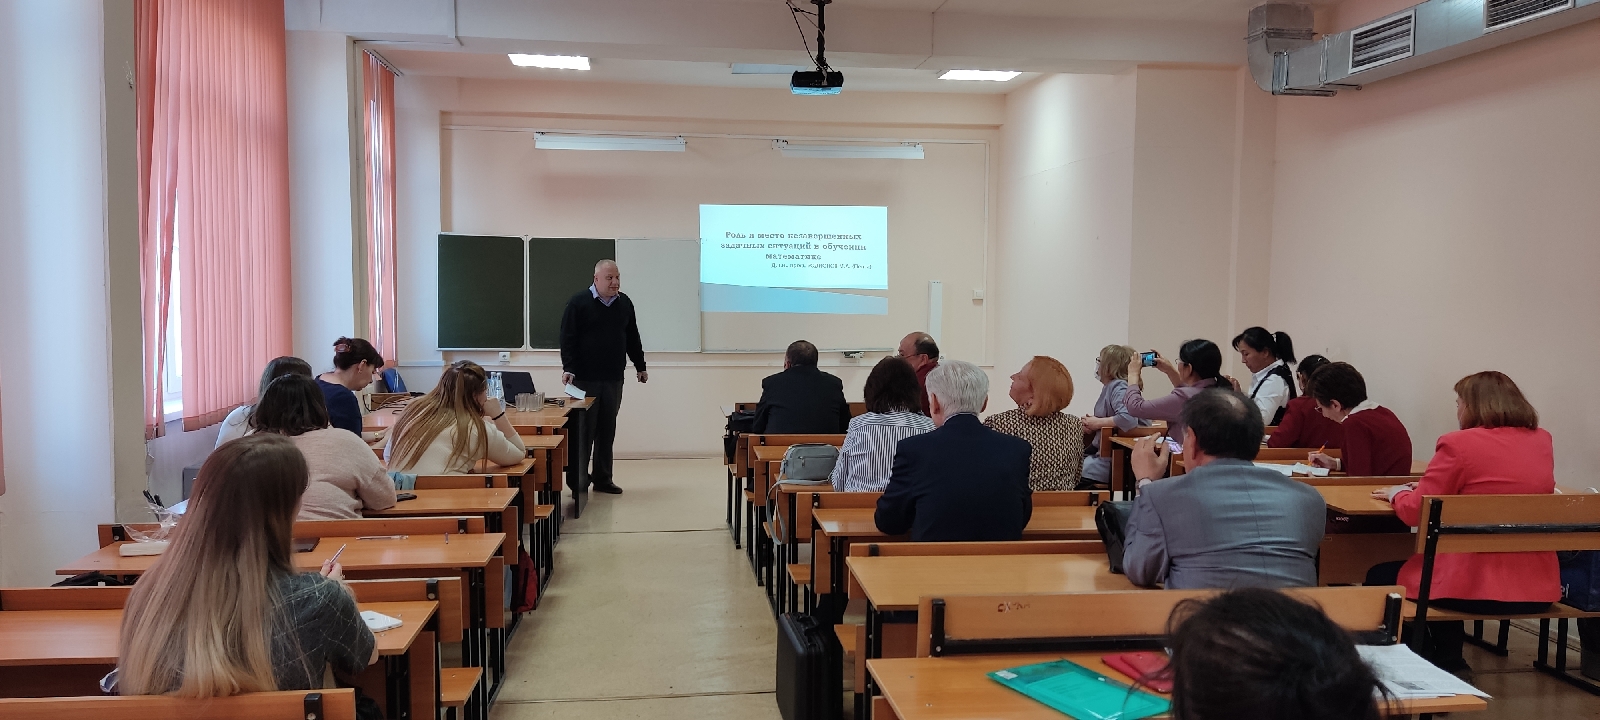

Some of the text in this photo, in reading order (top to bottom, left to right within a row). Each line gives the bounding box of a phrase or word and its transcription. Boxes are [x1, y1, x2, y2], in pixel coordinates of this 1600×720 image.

[725, 231, 746, 239] Роль
[788, 233, 862, 241] незавершенных
[768, 242, 812, 251] ситуаций
[823, 243, 867, 252] обучении
